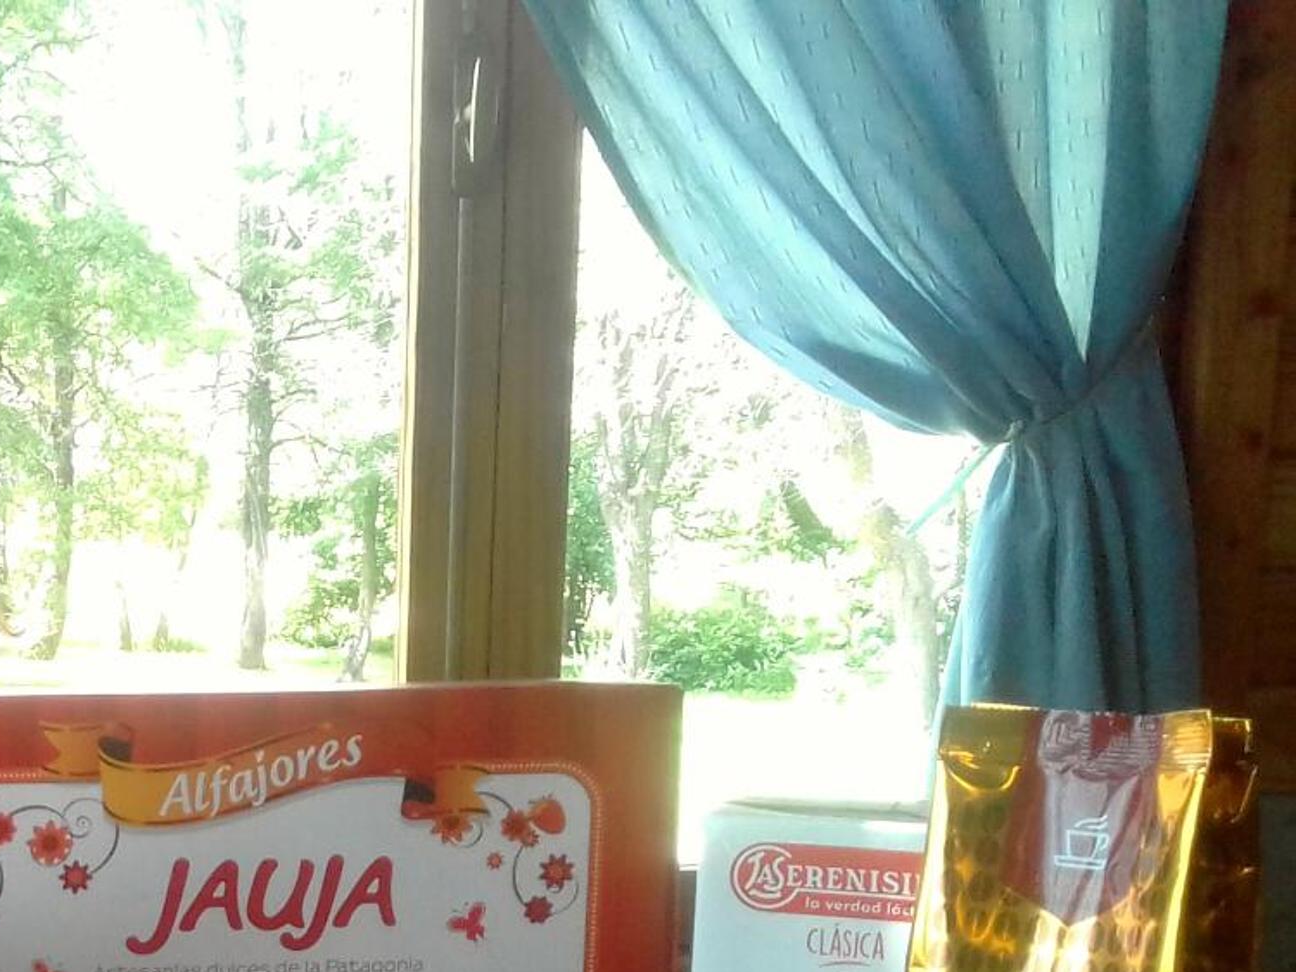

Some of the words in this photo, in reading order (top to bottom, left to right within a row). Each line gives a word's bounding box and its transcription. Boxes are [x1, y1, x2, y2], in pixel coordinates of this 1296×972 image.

[159, 733, 363, 818] Alfajores
[764, 856, 920, 896] SERENISI
[125, 854, 397, 955] JAUJA
[805, 896, 820, 909] la
[826, 900, 881, 914] verdad
[806, 923, 885, 961] CLÁSICA
